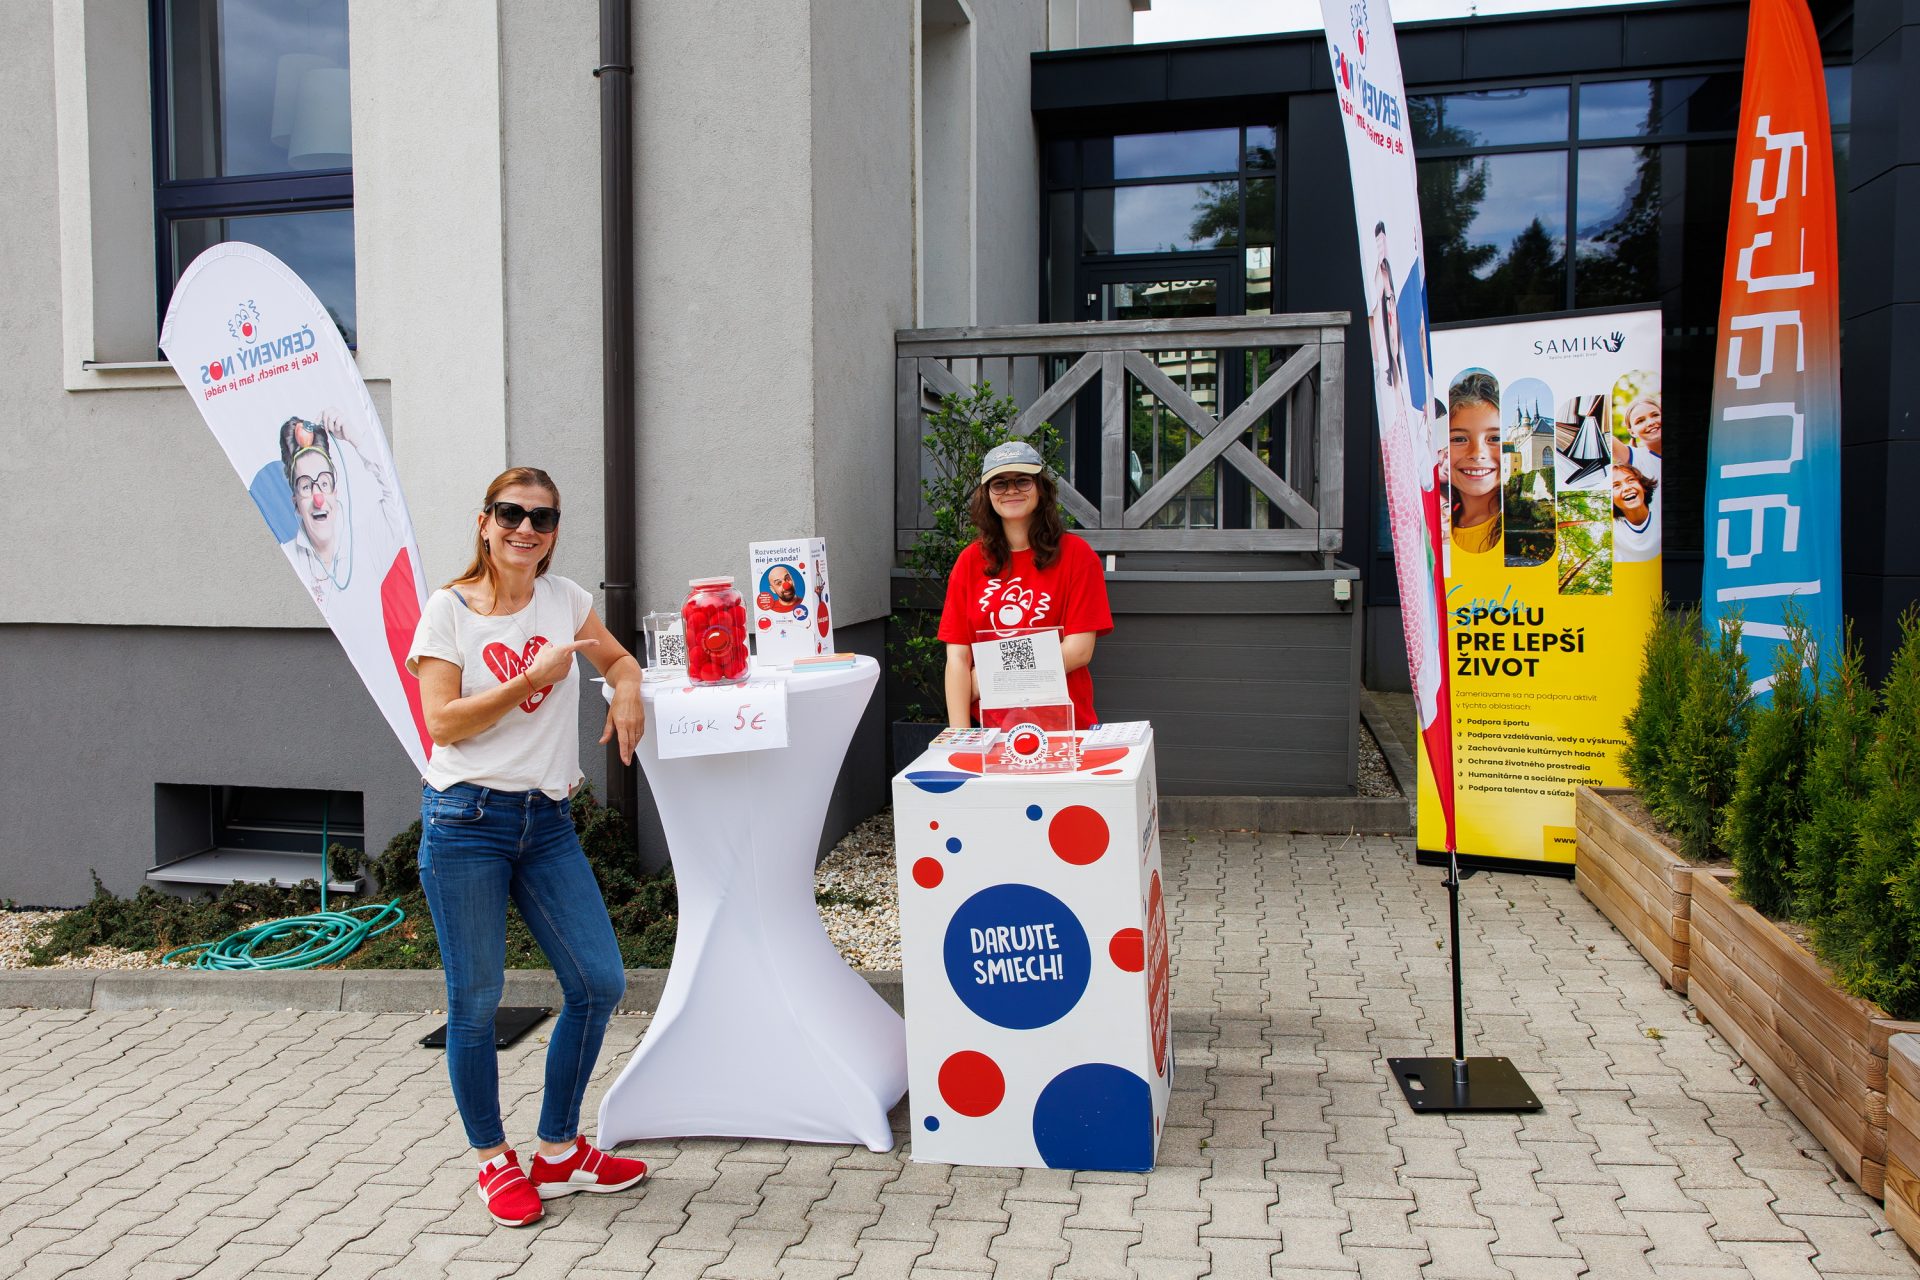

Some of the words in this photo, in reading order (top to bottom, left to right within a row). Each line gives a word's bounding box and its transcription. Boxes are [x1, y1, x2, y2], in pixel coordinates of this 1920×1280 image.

[788, 546, 801, 554] deti
[755, 556, 766, 564] nie
[766, 556, 773, 564] je
[774, 554, 799, 562] sranda!
[1456, 607, 1544, 626] SPOLU
[1457, 633, 1505, 651] PRE
[1514, 627, 1585, 653] LEPŠÍ
[1457, 652, 1540, 677] ŽIVOT
[1455, 690, 1511, 698] Zameriavame
[1536, 691, 1571, 702] podporu
[1467, 718, 1502, 727] Podpora
[1503, 718, 1530, 728] športu
[1467, 731, 1502, 740] Podpora
[1503, 733, 1555, 743] vzdelávania,
[1557, 736, 1577, 745] vedy
[1587, 736, 1627, 746] výskumu
[1468, 744, 1526, 753] Zachovávanie
[1527, 747, 1573, 757] kultúrnych
[1468, 758, 1504, 766] Ochrana
[1504, 759, 1545, 768] životného
[1547, 763, 1591, 771] prostredia
[1468, 771, 1523, 780] Humanitárne
[1531, 774, 1566, 783] sociálne
[1568, 777, 1603, 787] projekty
[1469, 784, 1503, 793] Podpora
[1504, 786, 1539, 795] talentov
[970, 923, 1060, 954] DARUJTE
[973, 954, 1064, 984] SMIECH!
